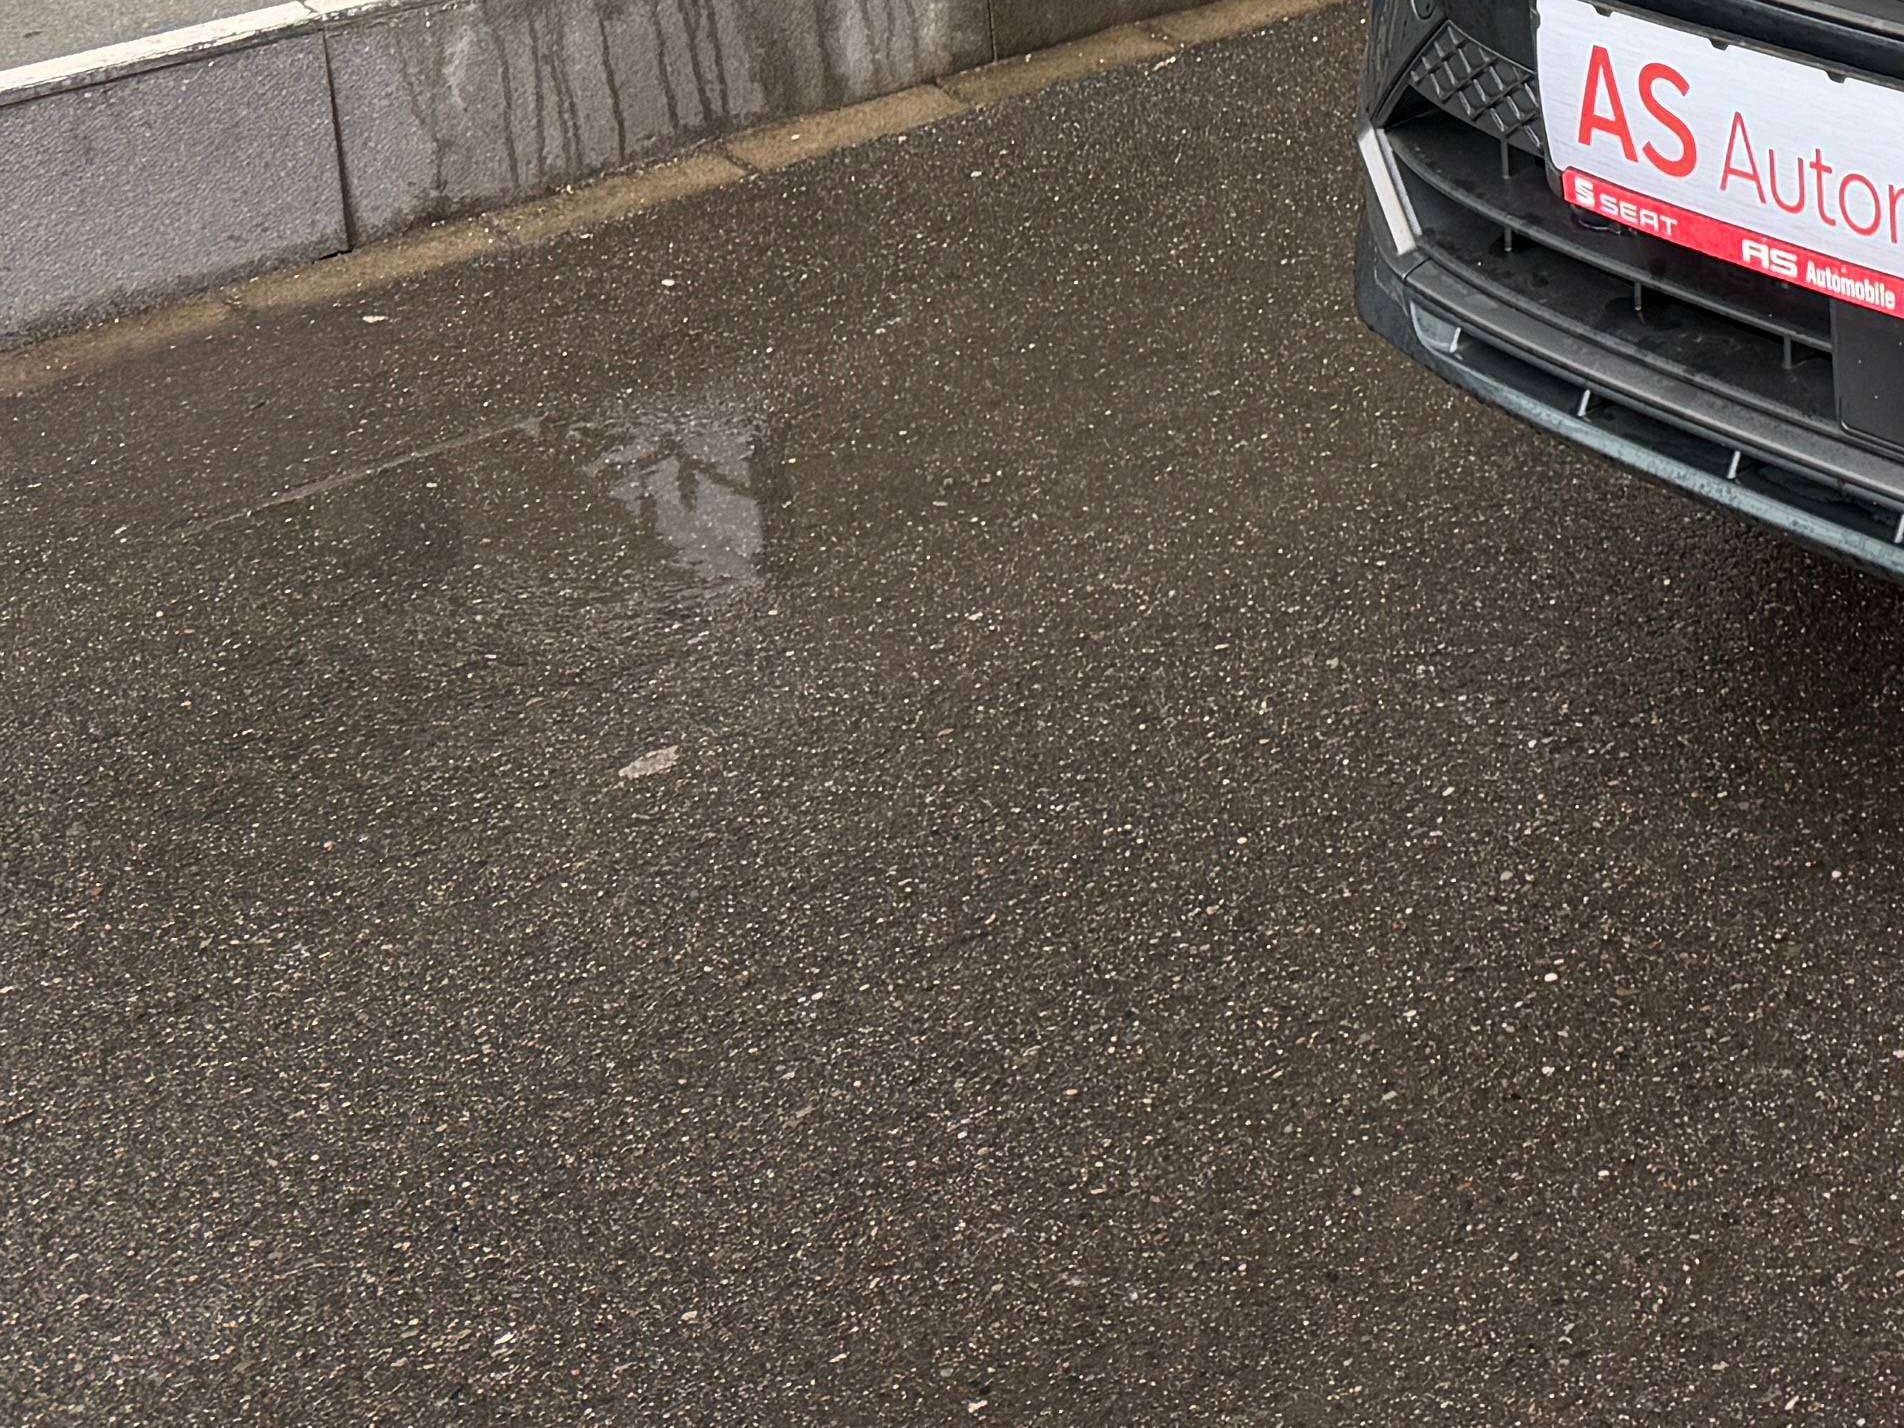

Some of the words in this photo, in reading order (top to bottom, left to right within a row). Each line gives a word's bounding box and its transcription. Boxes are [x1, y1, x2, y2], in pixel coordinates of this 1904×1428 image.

[1575, 43, 1699, 179] AS
[1598, 192, 1679, 237] SEAT
[1740, 238, 1799, 279] AS
[1805, 260, 1896, 310] Automobile
